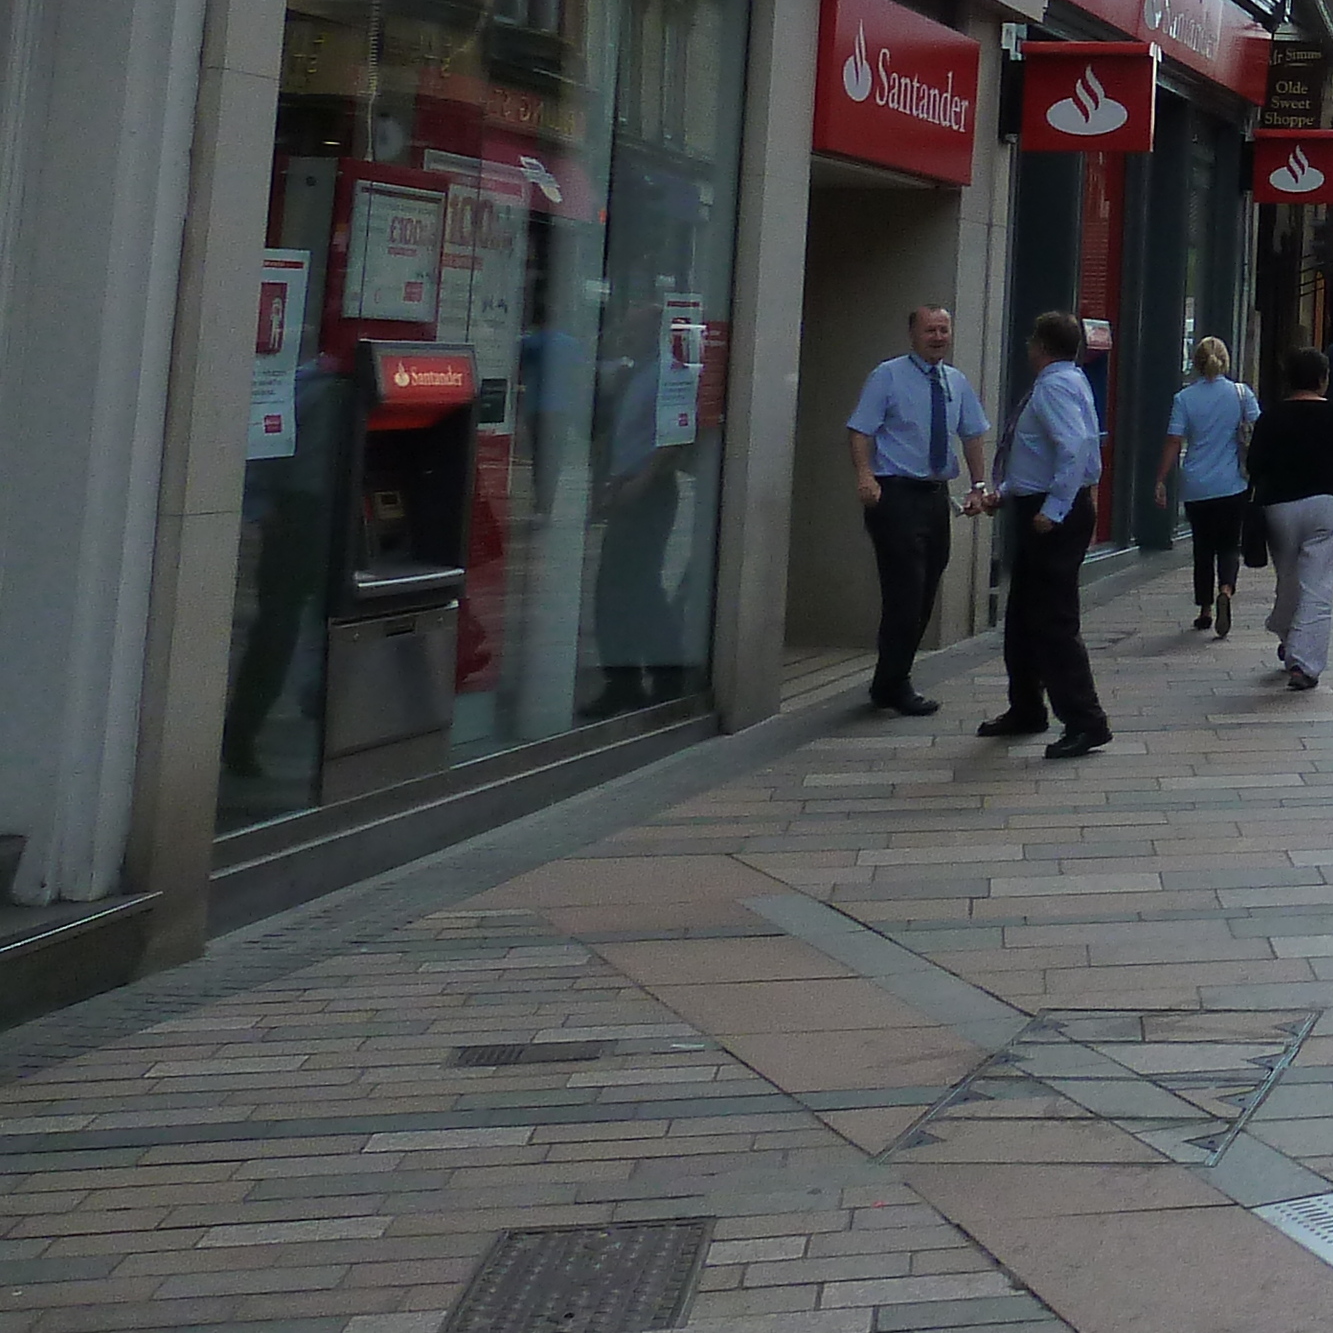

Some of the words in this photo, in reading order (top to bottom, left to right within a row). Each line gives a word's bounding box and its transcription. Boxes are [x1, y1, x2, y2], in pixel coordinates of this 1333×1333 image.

[1285, 48, 1322, 61] Simms
[875, 48, 969, 133] Santander
[1275, 80, 1309, 95] Olde
[1271, 96, 1311, 110] Sweet
[1264, 112, 1315, 128] Shoppe
[411, 364, 463, 387] Santander
